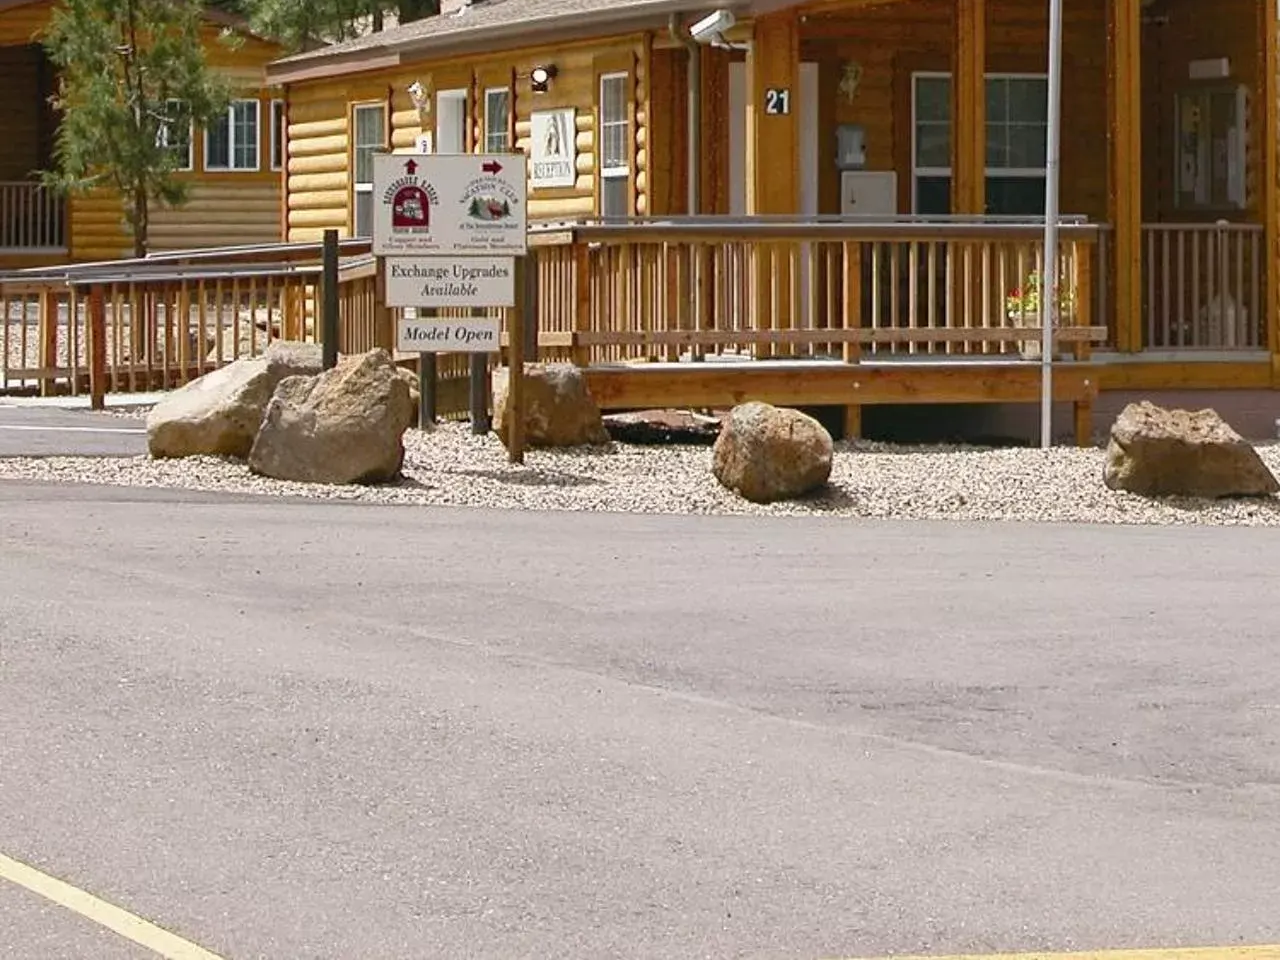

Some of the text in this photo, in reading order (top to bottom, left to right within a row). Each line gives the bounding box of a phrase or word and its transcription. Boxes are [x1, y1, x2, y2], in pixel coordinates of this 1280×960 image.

[767, 89, 789, 114] 21
[391, 264, 509, 280] Exchange Upgrades
[420, 283, 478, 297] Available
[404, 327, 493, 344] Model Open
